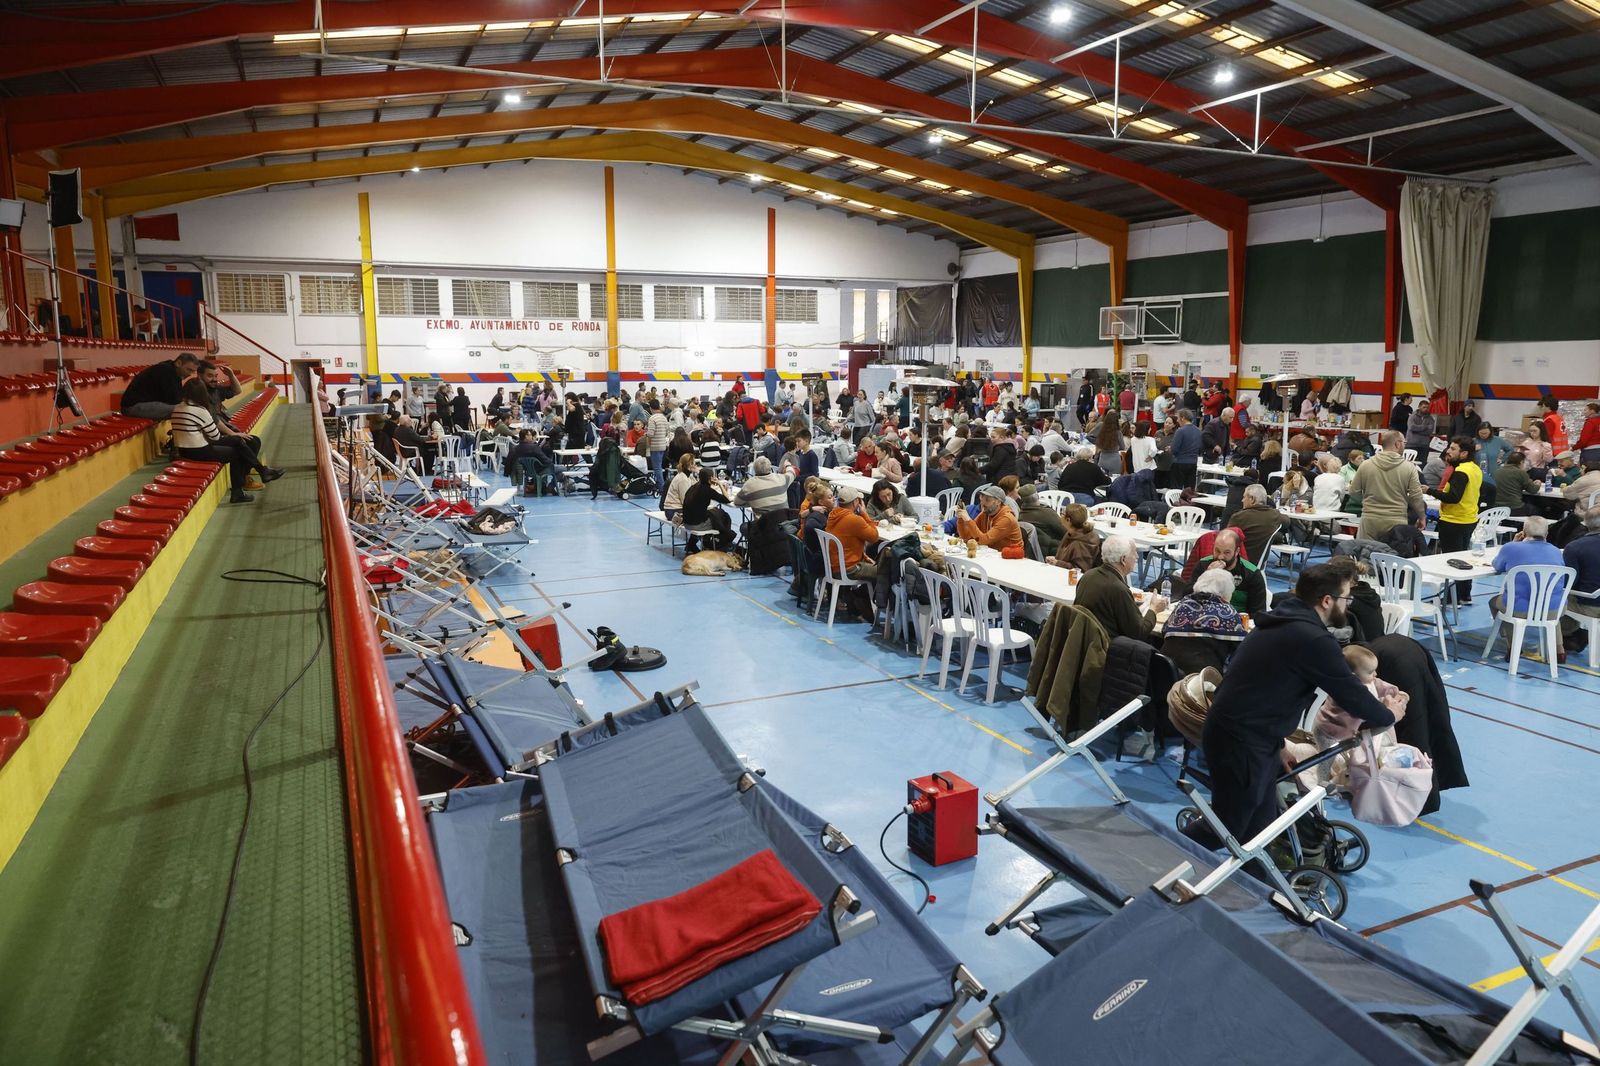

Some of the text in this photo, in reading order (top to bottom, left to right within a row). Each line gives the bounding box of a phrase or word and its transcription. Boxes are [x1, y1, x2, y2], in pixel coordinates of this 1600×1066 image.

[426, 319, 601, 332] EXCMO. AYUNTAMIENTO DE RONDA
